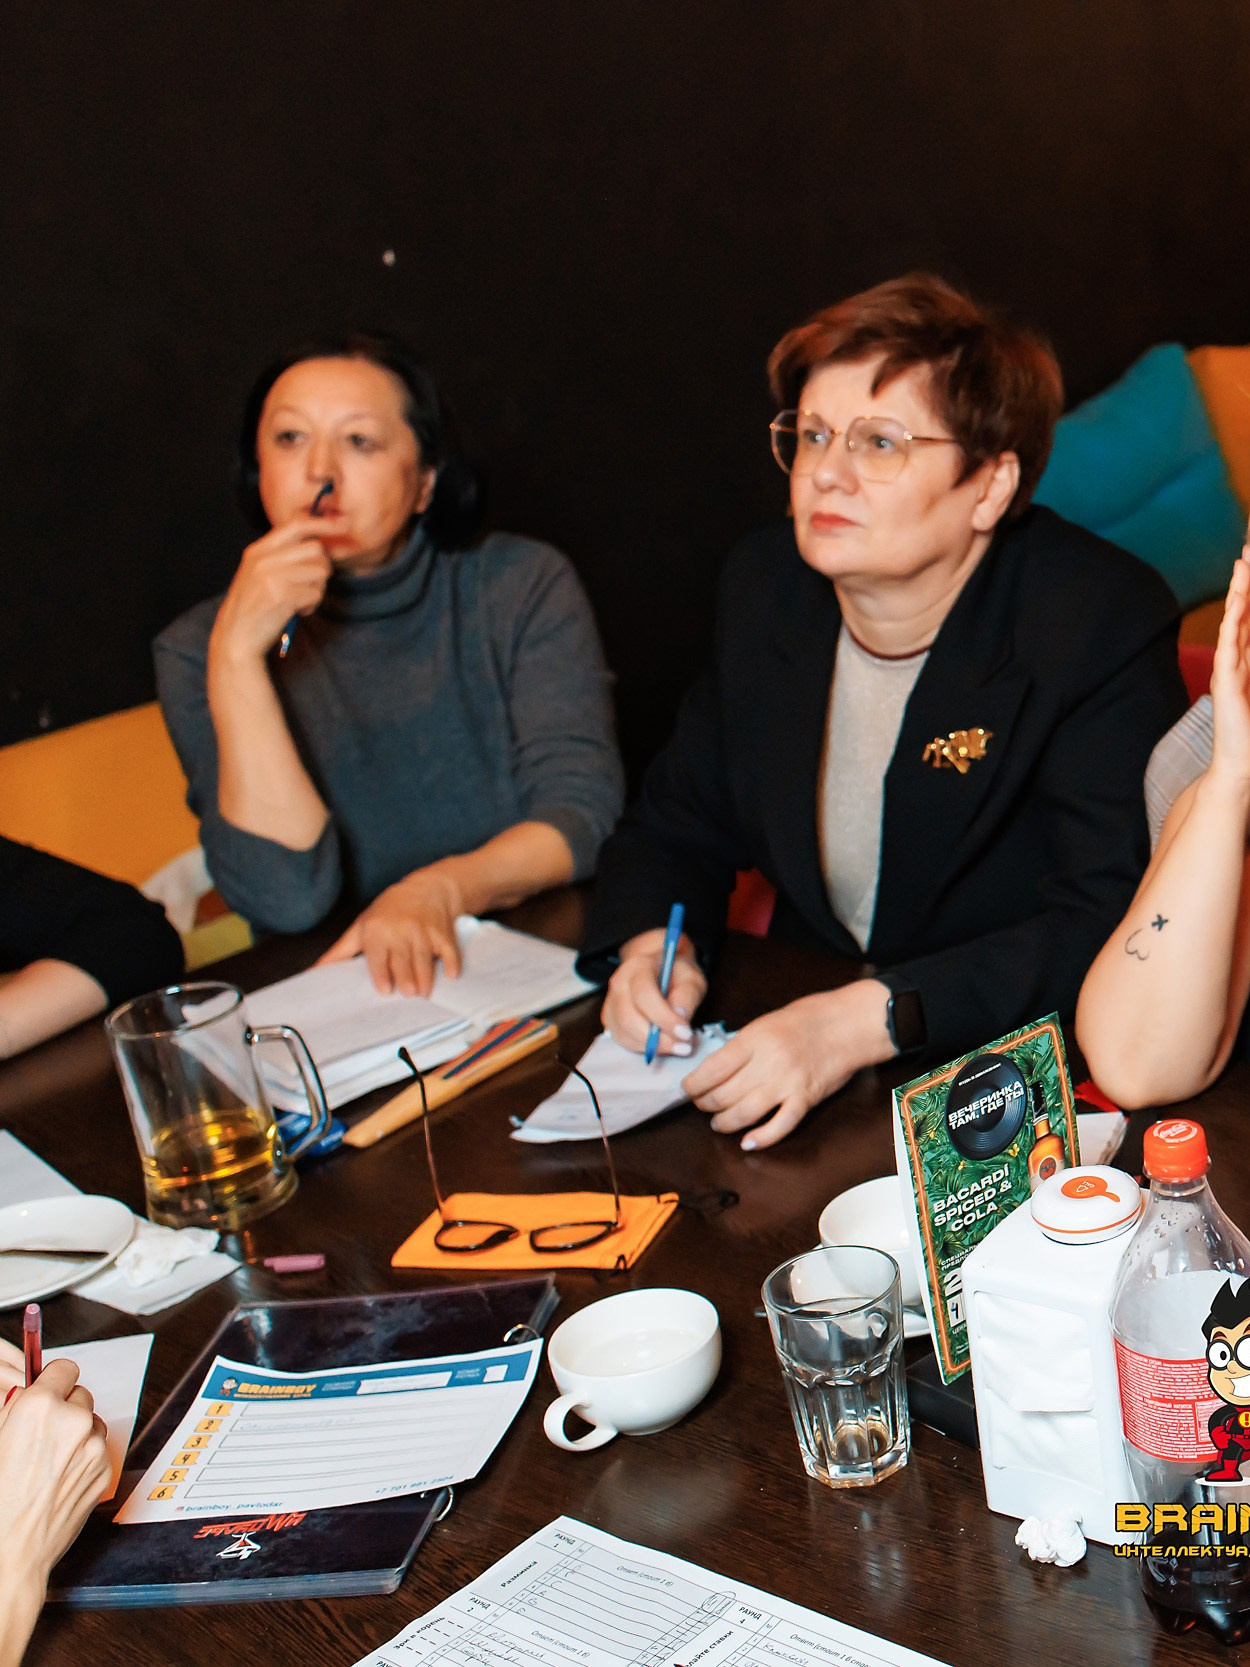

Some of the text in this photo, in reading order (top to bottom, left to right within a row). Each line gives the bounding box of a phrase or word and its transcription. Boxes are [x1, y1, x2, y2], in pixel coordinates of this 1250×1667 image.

[948, 1080, 1023, 1123] ВЕЧЕРИНКА
[948, 1087, 1025, 1130] ТАМ, ГДЕ ТЫ
[934, 1179, 1013, 1227] SPICED &
[951, 1203, 999, 1233] COLA
[204, 1419, 214, 1430] 2
[191, 1437, 202, 1447] 3
[181, 1453, 191, 1464] 4
[169, 1470, 180, 1481] 5
[157, 1487, 168, 1498] 6
[554, 1533, 577, 1546] РАУНД
[500, 1560, 538, 1588] Разминка
[469, 1597, 491, 1611] РАУНД
[739, 1606, 762, 1620] РАУНД
[709, 1630, 734, 1650] ставки
[790, 1633, 814, 1647] Ответ
